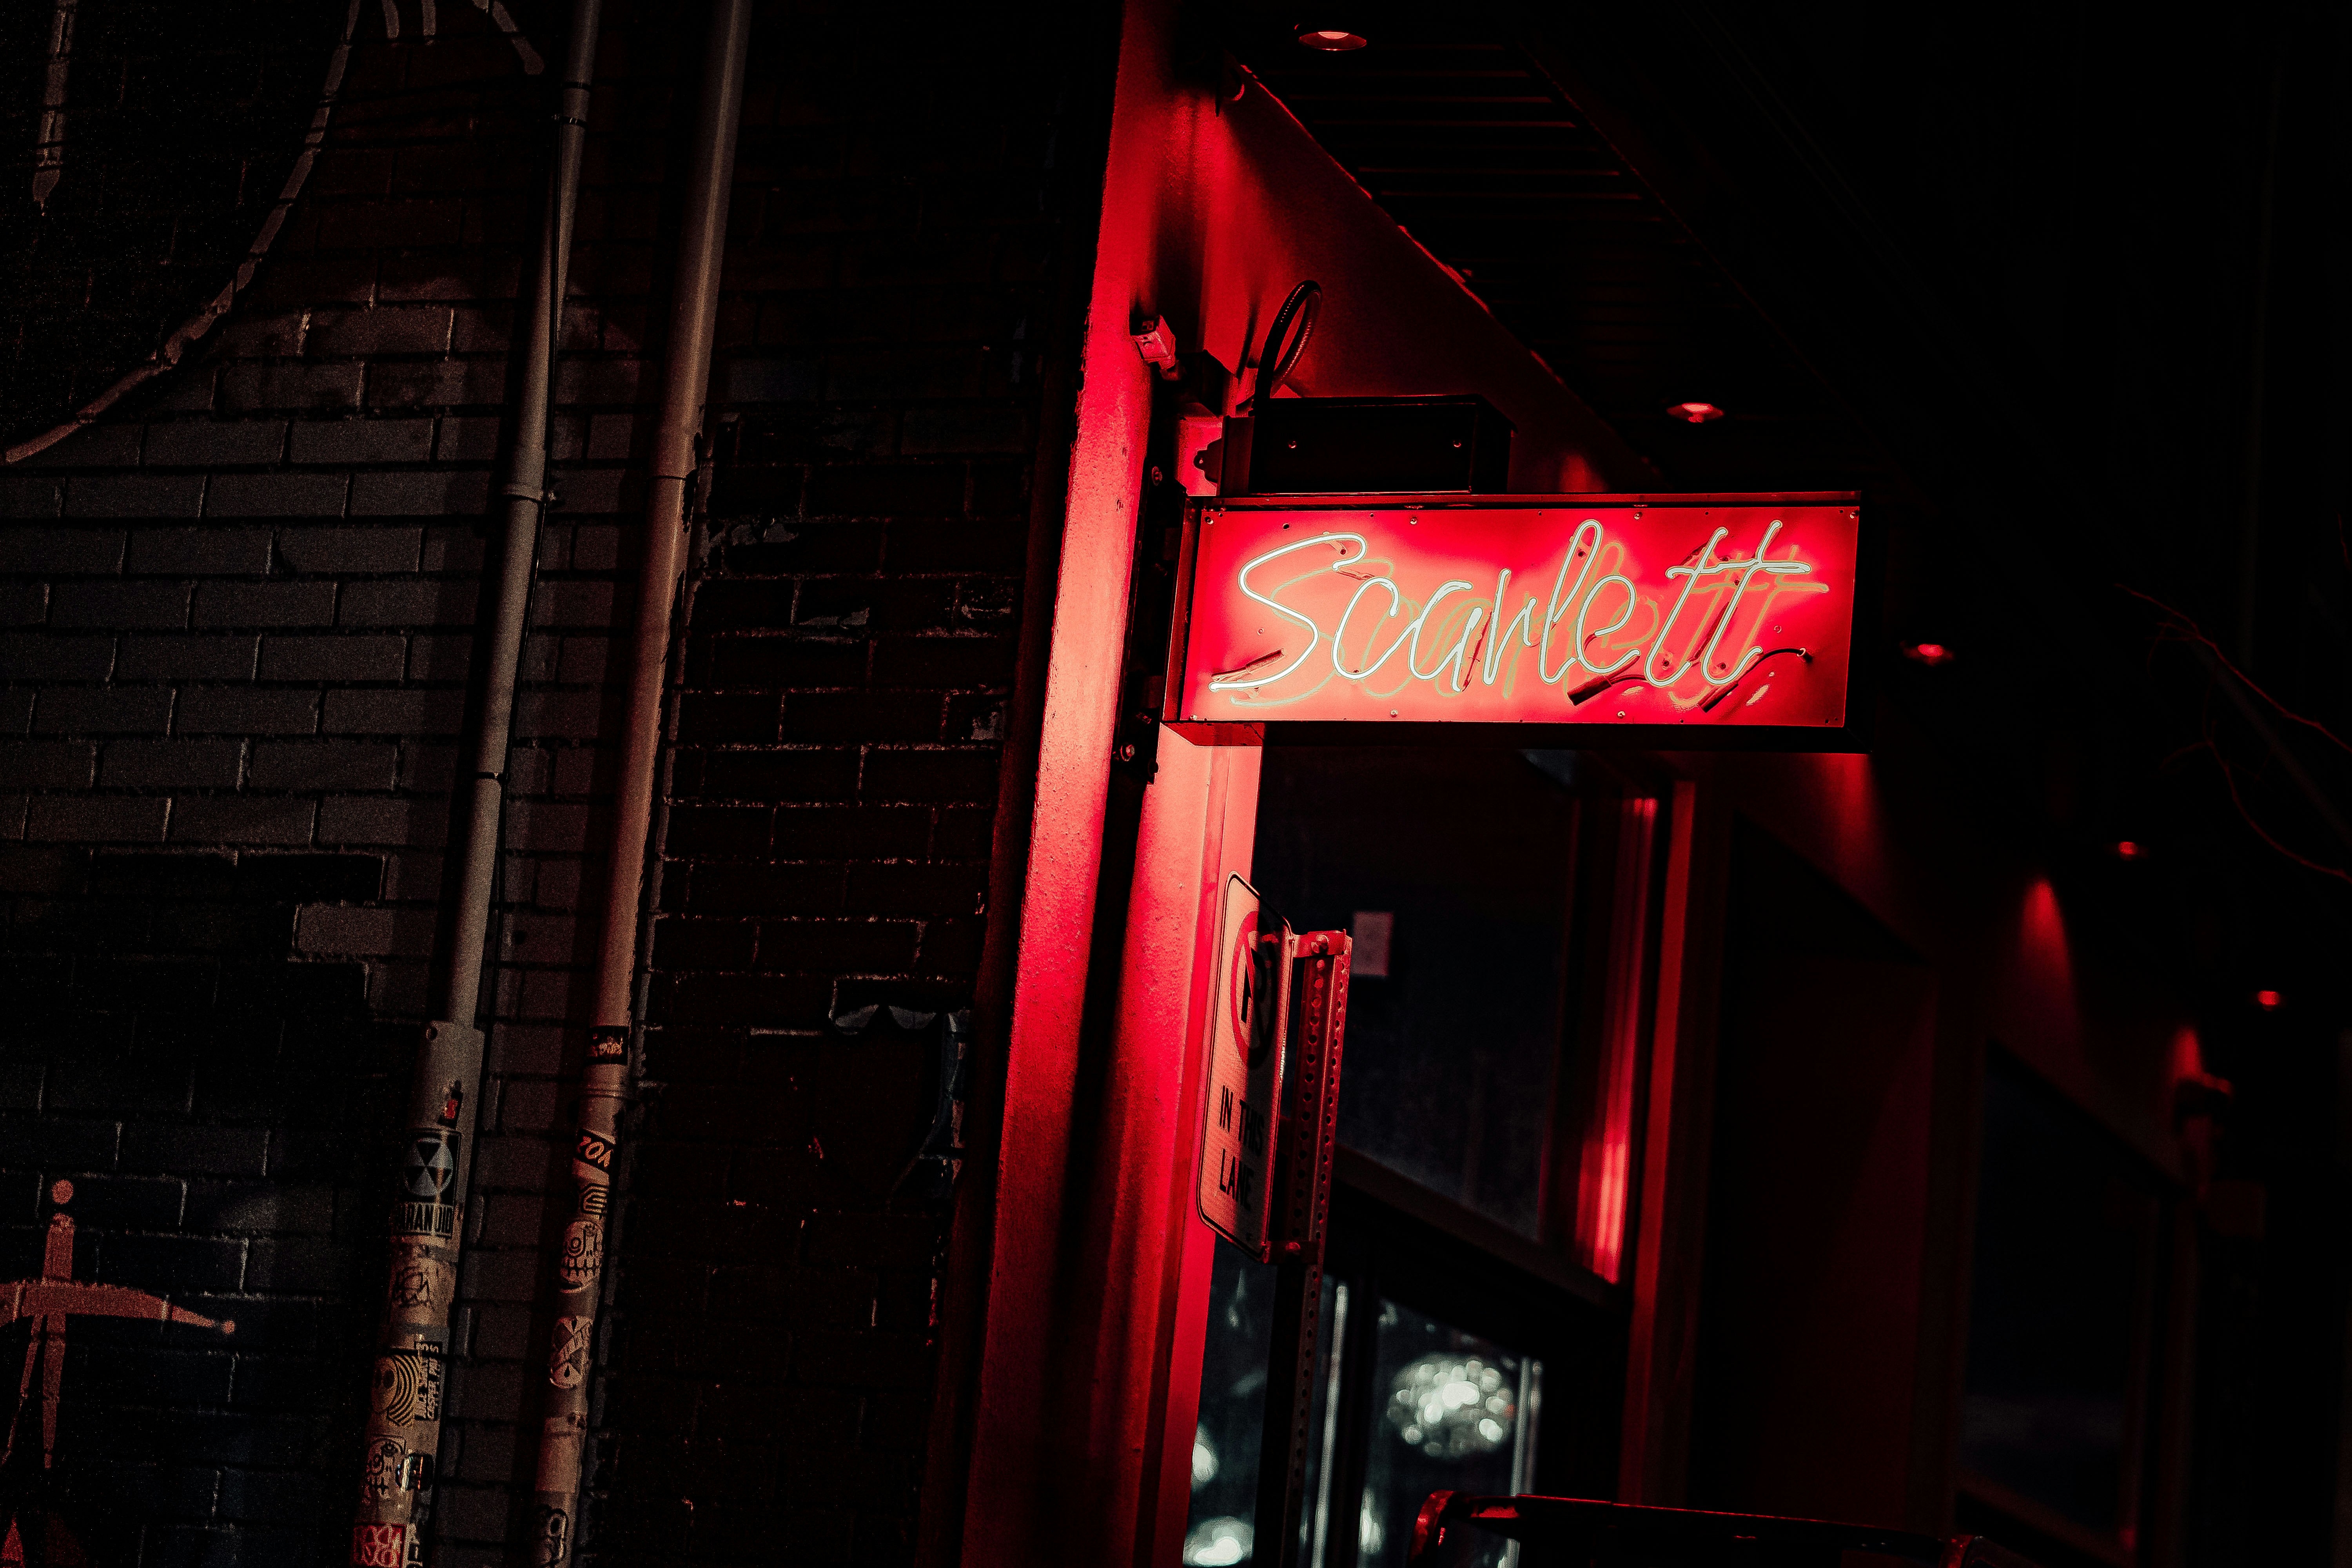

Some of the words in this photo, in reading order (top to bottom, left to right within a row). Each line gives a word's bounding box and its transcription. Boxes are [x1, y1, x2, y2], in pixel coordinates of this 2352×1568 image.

[1208, 518, 1812, 693] Scarlett
[1219, 1084, 1234, 1133] IN
[1238, 1098, 1265, 1156] THIS
[1219, 1147, 1254, 1211] LANE
